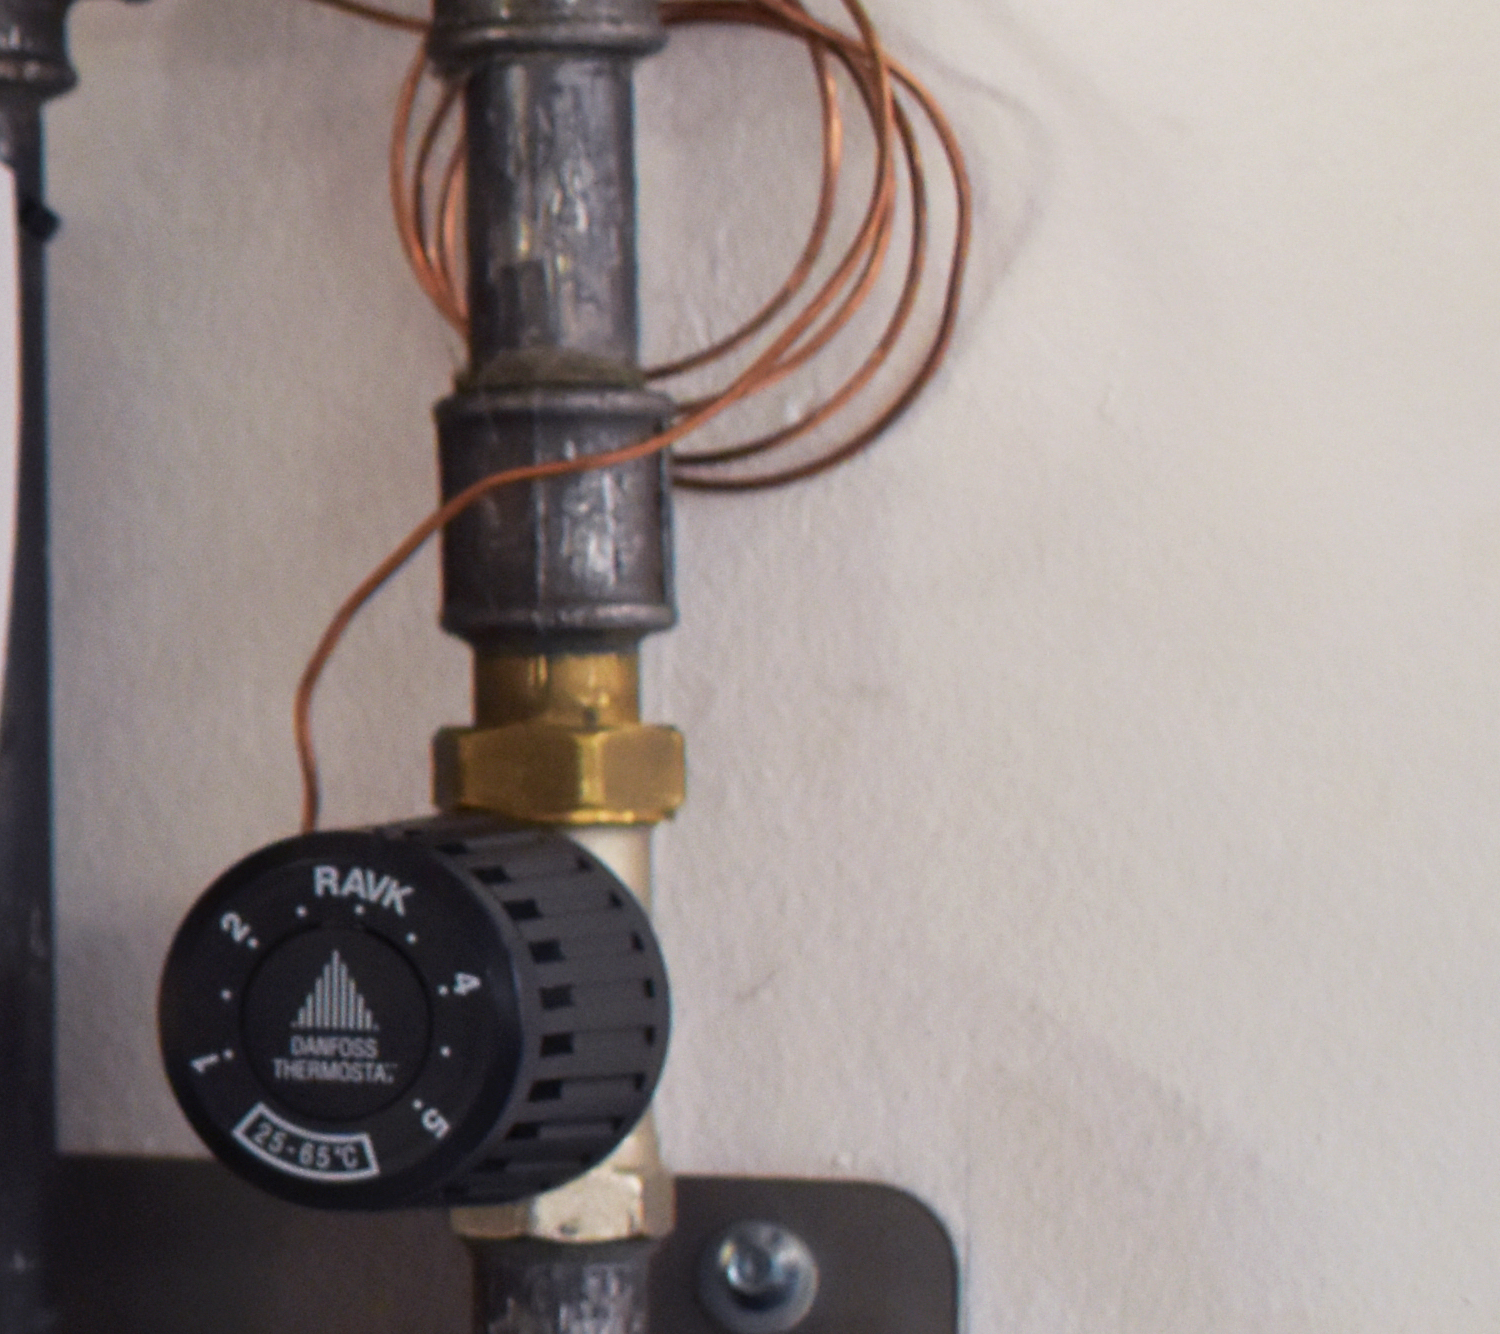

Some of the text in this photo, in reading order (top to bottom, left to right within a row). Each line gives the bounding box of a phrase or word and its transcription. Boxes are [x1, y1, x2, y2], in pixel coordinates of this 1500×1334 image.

[312, 864, 415, 916] RAVK
[219, 912, 251, 943] 2
[452, 971, 483, 997] 4
[290, 1035, 378, 1059] DANFOSS
[420, 1107, 452, 1139] 5
